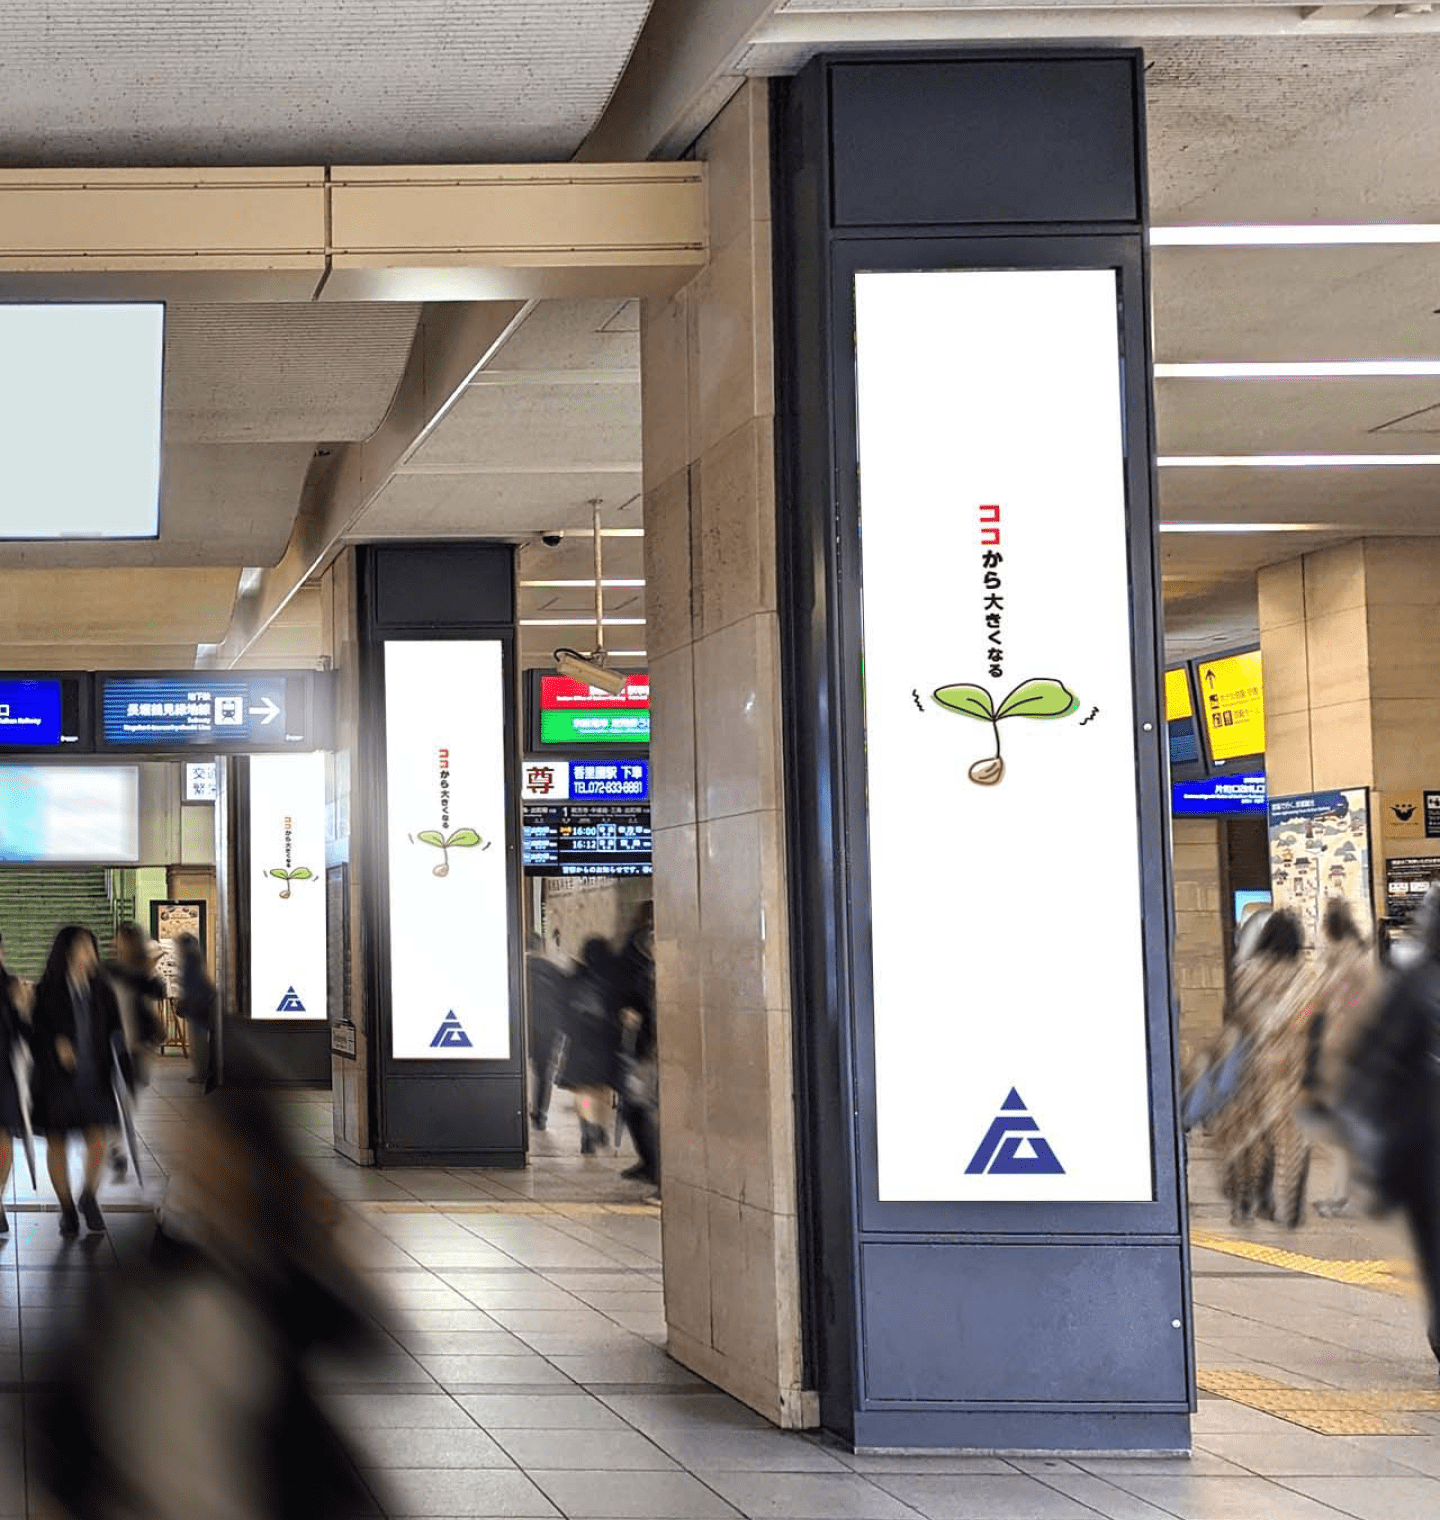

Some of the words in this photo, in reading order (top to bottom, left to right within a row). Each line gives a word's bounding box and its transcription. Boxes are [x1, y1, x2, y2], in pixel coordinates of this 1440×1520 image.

[979, 504, 1004, 678] ココから大きくなる
[526, 767, 555, 794] 尊
[572, 840, 596, 849] 16:12
